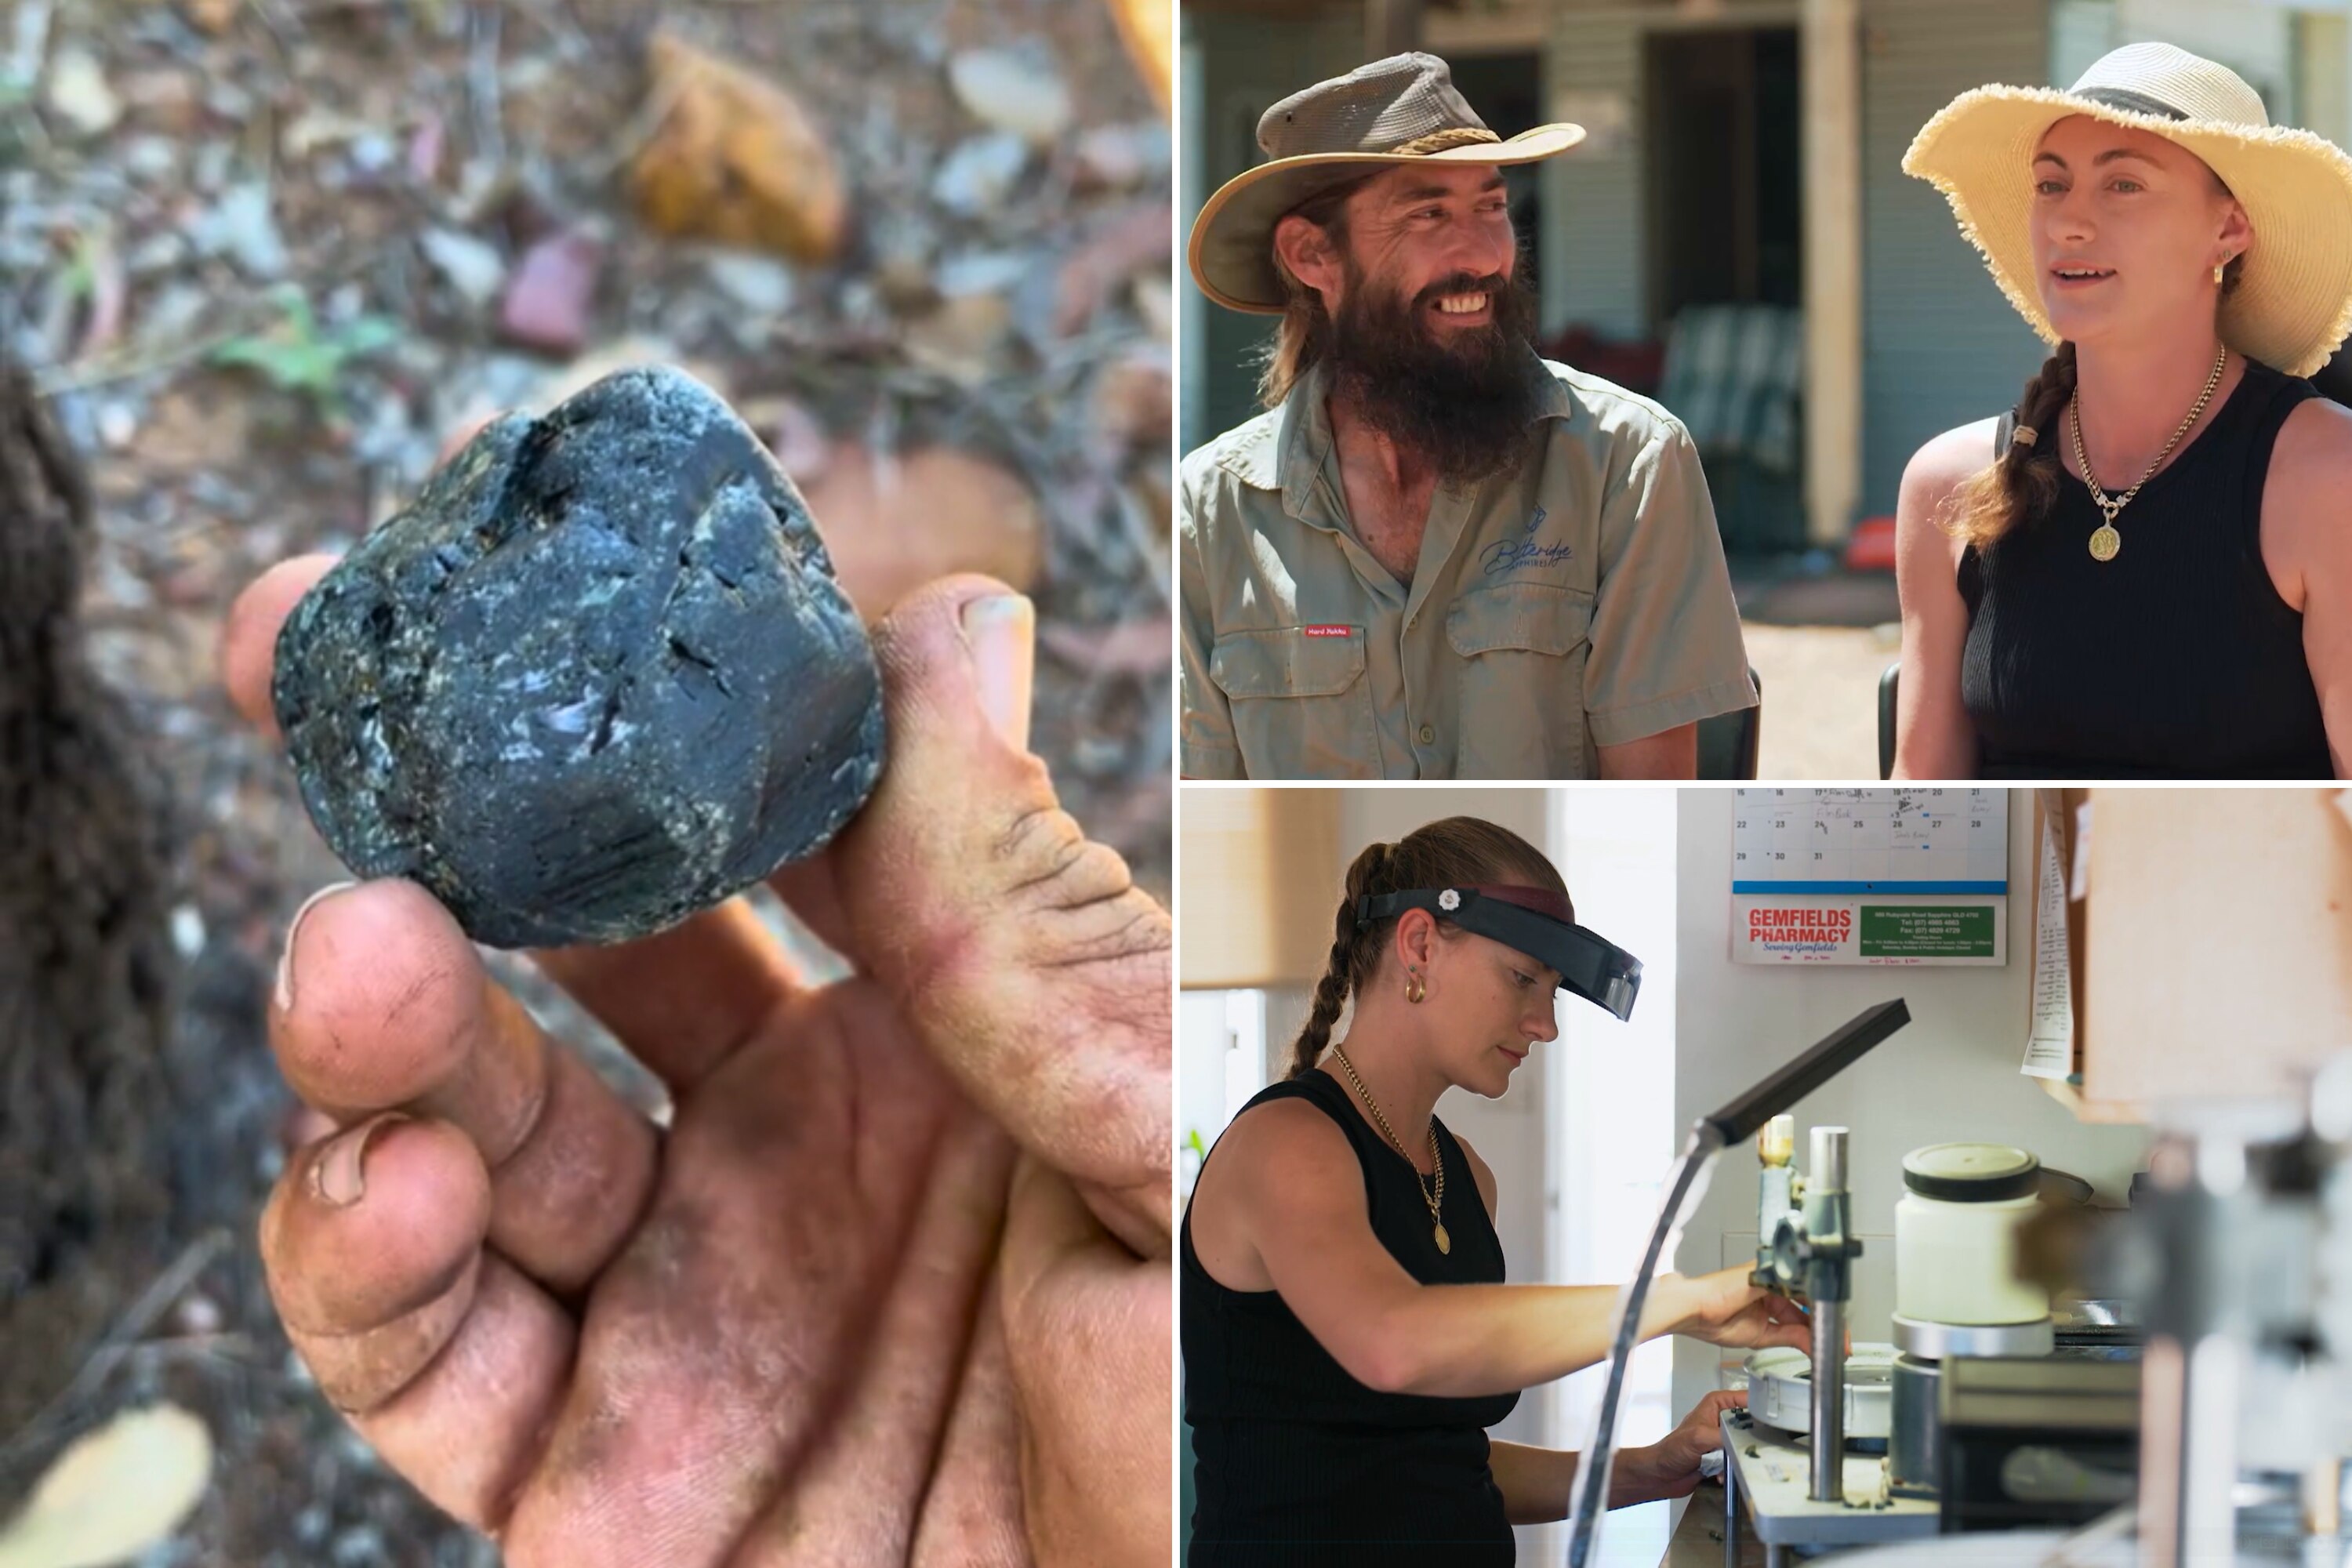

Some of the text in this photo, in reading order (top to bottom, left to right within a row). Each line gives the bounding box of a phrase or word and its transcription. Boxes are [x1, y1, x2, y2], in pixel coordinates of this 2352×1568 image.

[1737, 852, 1823, 861] 29 30 31
[1749, 909, 1851, 927] GEMFIELDS
[1749, 928, 1851, 942] PHARMACY
[1763, 942, 1838, 953] Serving Gemfields
